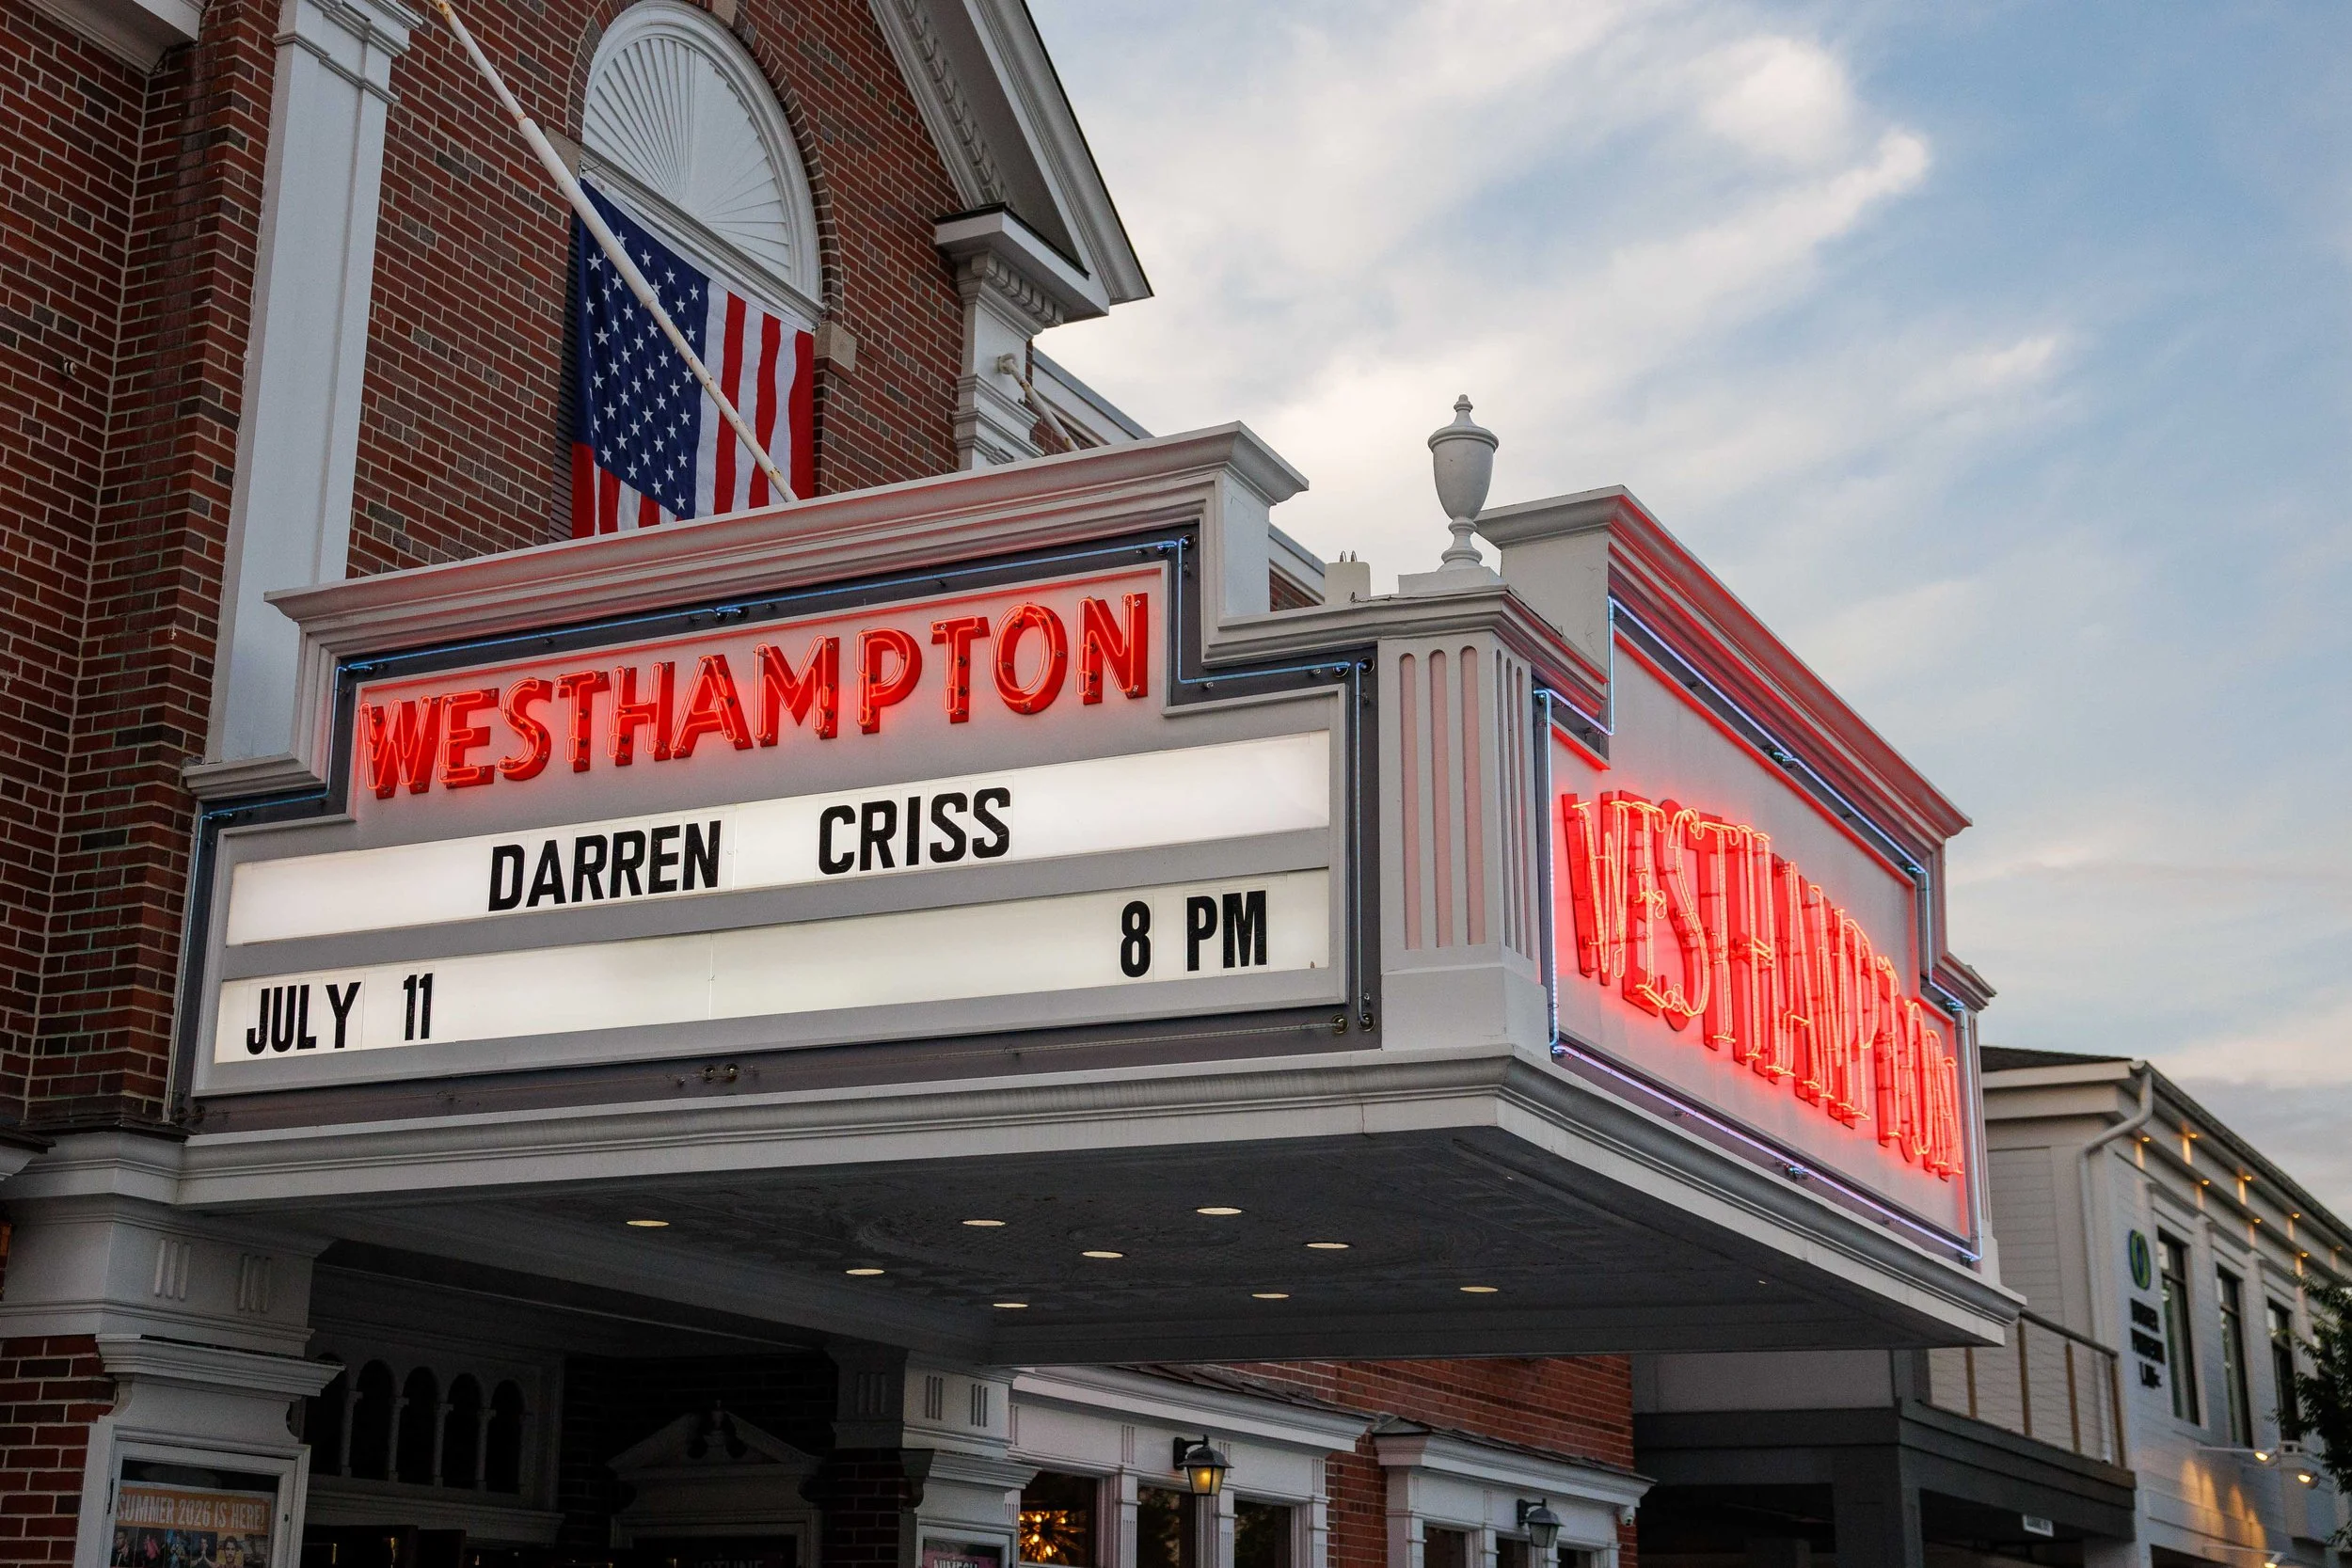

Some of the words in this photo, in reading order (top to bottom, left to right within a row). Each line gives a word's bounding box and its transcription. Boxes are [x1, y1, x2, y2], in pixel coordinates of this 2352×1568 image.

[358, 591, 1149, 799] WESTHAMPTON
[488, 820, 722, 911] DARREN
[818, 787, 1011, 875] CRISS
[246, 981, 361, 1054] JULY
[403, 973, 433, 1040] 11
[1120, 900, 1152, 978] 8
[1186, 890, 1267, 972] PM
[1562, 790, 1963, 1181] WESTHAMPTON
[118, 1494, 175, 1525] SUMMER
[177, 1499, 213, 1527] 2026
[215, 1502, 228, 1528] IS
[230, 1505, 265, 1531] HERE!
